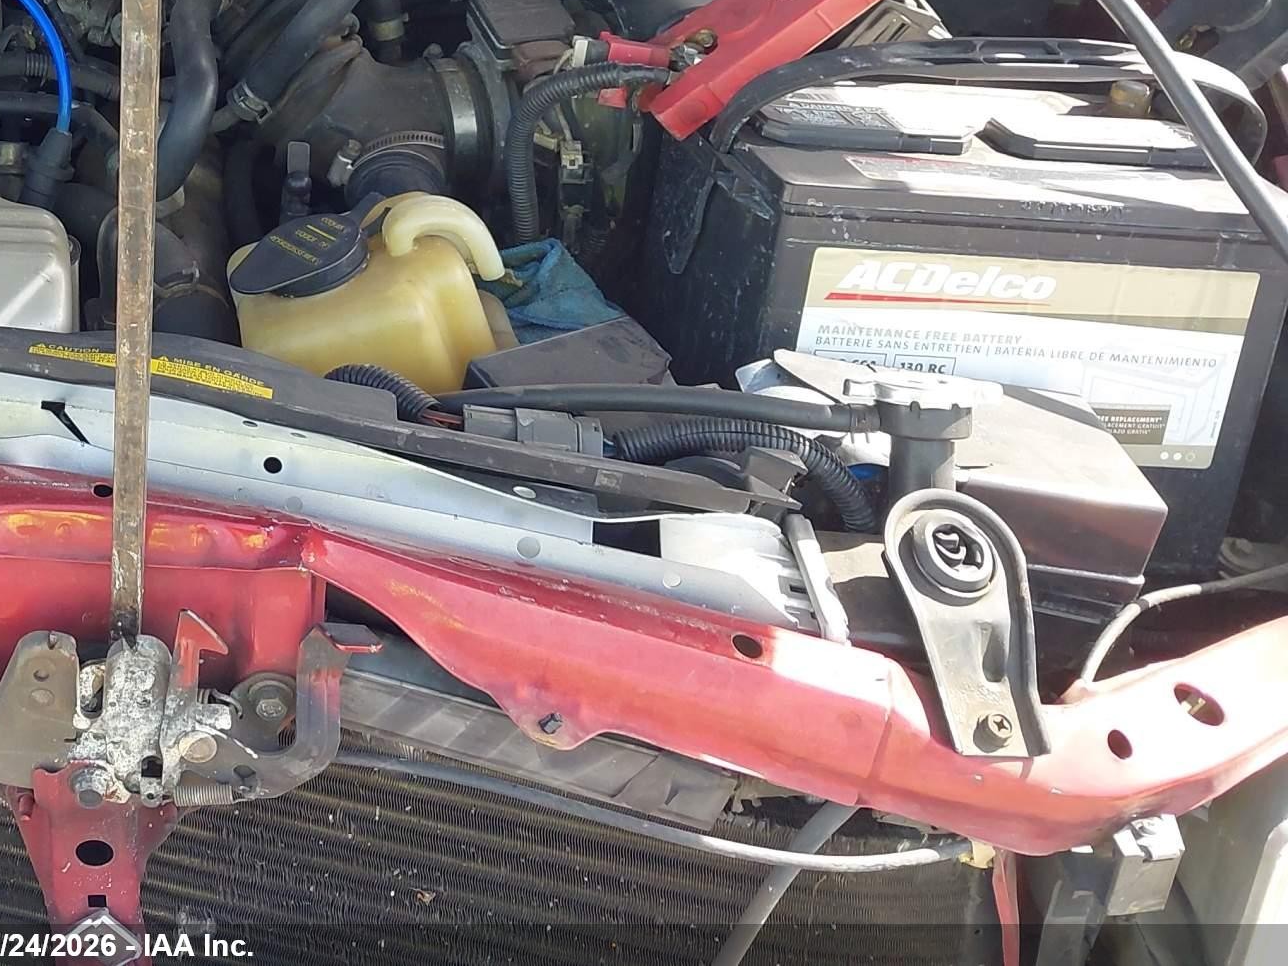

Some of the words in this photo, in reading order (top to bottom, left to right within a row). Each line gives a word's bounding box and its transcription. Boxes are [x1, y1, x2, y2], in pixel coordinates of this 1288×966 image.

[835, 259, 1058, 301] ACDelco
[47, 343, 101, 353] CAUTION
[817, 324, 921, 340] MAINTENANCE
[925, 330, 958, 342] FREE
[962, 333, 1023, 345] BATTERY
[815, 336, 874, 348] BATTERIE
[878, 340, 910, 351] SANS
[913, 341, 982, 355] ENTRETIEN
[1050, 350, 1085, 361] LIBRE
[1089, 351, 1105, 362] DE
[1108, 353, 1218, 369] MANTENIMIENTO
[173, 357, 202, 368] MISE
[223, 370, 265, 386] GARDE
